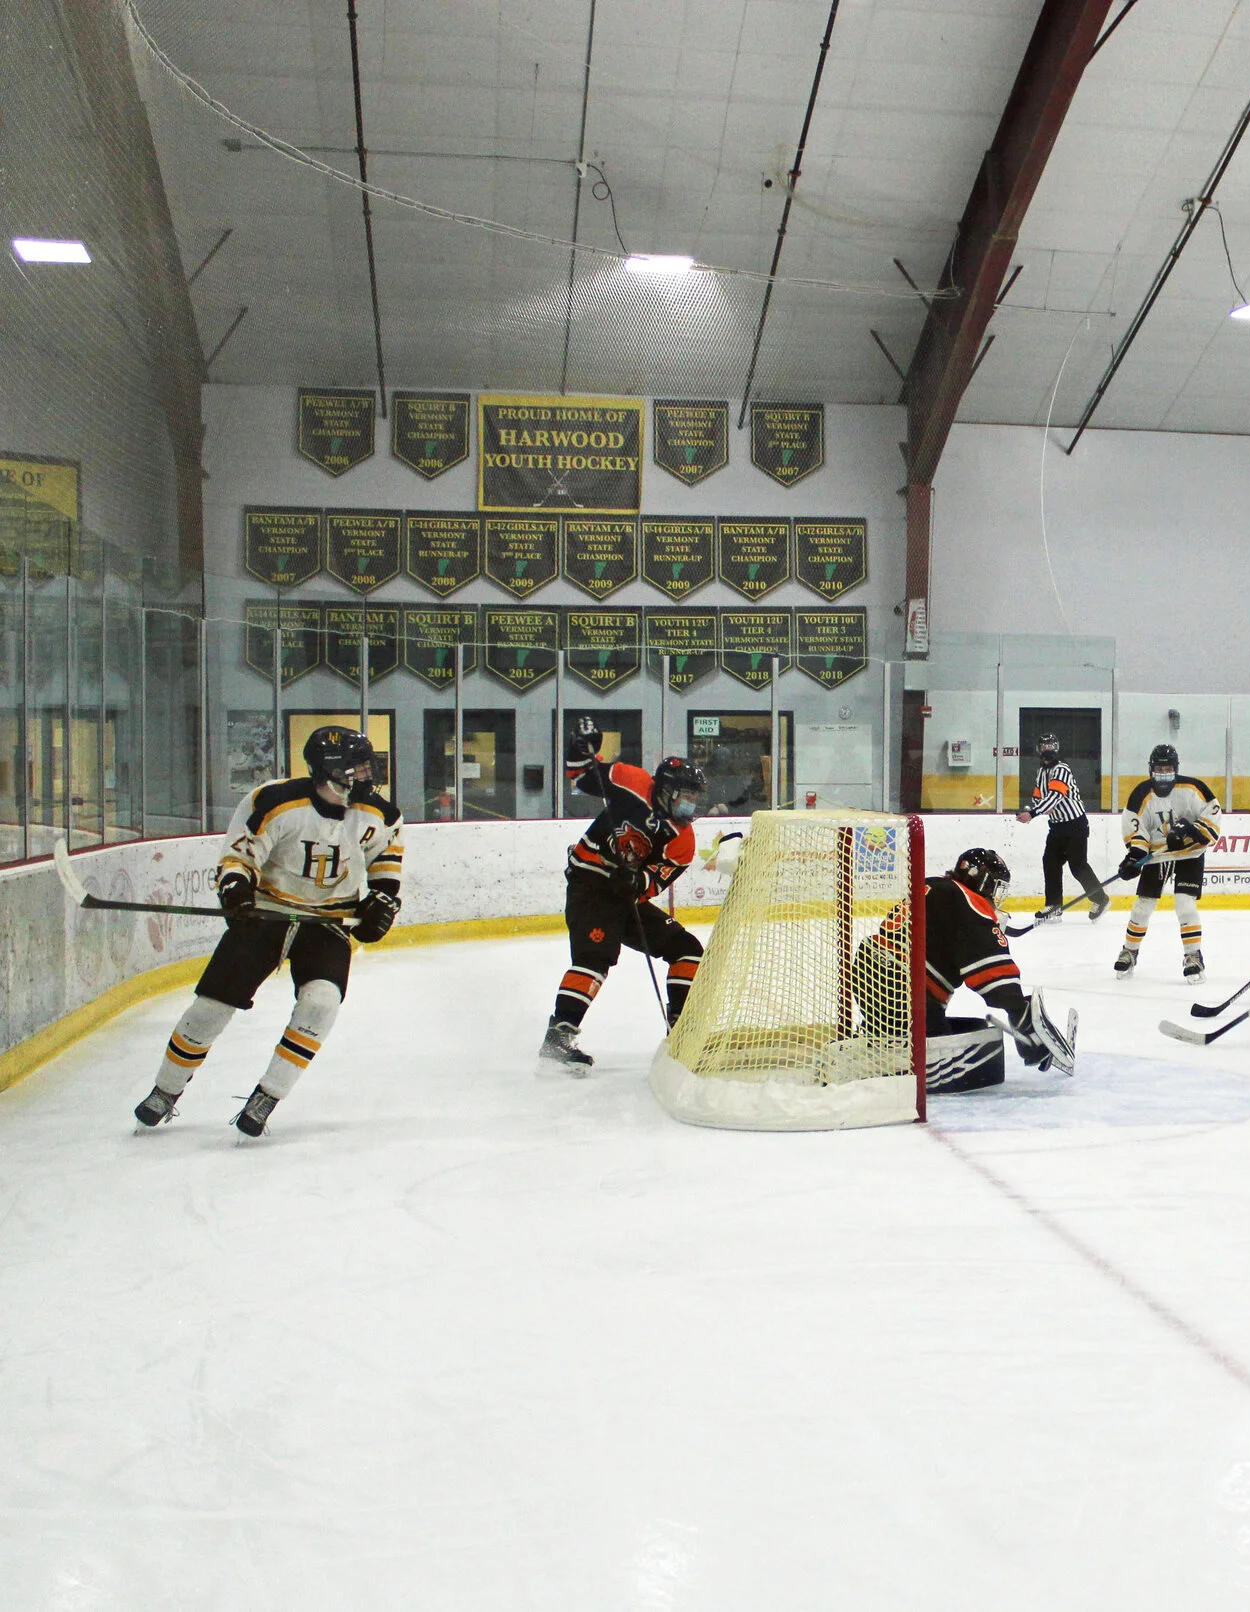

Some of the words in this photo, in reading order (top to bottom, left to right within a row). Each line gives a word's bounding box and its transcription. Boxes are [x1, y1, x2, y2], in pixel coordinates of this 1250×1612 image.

[407, 403, 446, 412] SQUIRT
[409, 412, 454, 421] VERMONT
[499, 408, 551, 421] PROUD
[557, 410, 602, 421] HOME
[607, 412, 628, 423] OF
[764, 413, 801, 422] SQUIRT
[419, 423, 445, 431] STATE
[408, 432, 455, 440] CHAMPION
[499, 429, 625, 449] HARWOOD
[419, 459, 443, 468] 2006
[485, 453, 553, 469] YOUTH
[557, 455, 639, 471] HOCKEY
[680, 465, 703, 474] 2007
[777, 467, 799, 475] 2007
[251, 516, 295, 525] BANTAM
[333, 519, 374, 528] PEEWEE
[377, 520, 396, 529] A/B
[429, 521, 459, 529] GIRLS
[460, 522, 478, 530] A/B
[506, 523, 537, 531] GIRLS
[538, 524, 556, 532] A/B
[569, 524, 611, 533] BANTAM
[613, 525, 633, 533] A/B
[342, 529, 386, 537] VERMONT
[421, 531, 466, 539] VERMONT
[663, 526, 693, 534] GIRLS
[694, 527, 712, 535] A/B
[723, 526, 766, 535] BANTAM
[767, 527, 786, 535] A/B
[815, 527, 845, 535] GIRLS
[845, 528, 863, 536] A/B
[499, 533, 544, 541] VERMONT
[579, 534, 622, 542] VERMONT
[656, 536, 699, 544] VERMONT
[732, 536, 776, 544] VERMONT
[810, 537, 852, 545] VERMONT
[350, 539, 377, 547] STATE
[430, 541, 457, 549] STATE
[508, 542, 535, 550] STATE
[257, 546, 308, 554] CHAMPION
[357, 549, 385, 557] PLACE
[665, 545, 691, 553] STATE
[818, 546, 843, 554] STATE
[418, 550, 469, 558] RUNNER-UP
[514, 552, 542, 560] PLACE
[577, 553, 624, 561] CHAMPION
[653, 554, 703, 562] RUNNER-UP
[731, 555, 778, 563] CHAMPION
[351, 575, 376, 584] 2008
[431, 577, 456, 586] 2008
[510, 579, 534, 588] 2009
[588, 579, 613, 589] 2009
[666, 580, 690, 590] 2009
[742, 581, 767, 590] 2010
[819, 581, 843, 590] 2010
[387, 613, 395, 622] A
[407, 614, 461, 627] SQUIRT
[464, 615, 473, 625] B
[491, 615, 543, 626] PEEWEE
[545, 616, 554, 626] A
[728, 616, 765, 624] YOUTH
[766, 616, 784, 624] 12U
[804, 616, 840, 624] YOUTH
[841, 616, 858, 624] 10U
[571, 616, 622, 629] SQUIRT
[625, 617, 635, 627] B
[654, 619, 690, 627] YOUTH
[692, 619, 709, 627] 12U
[666, 629, 691, 637] TIER
[816, 626, 841, 634] TIER
[428, 668, 453, 678] 2014
[509, 669, 535, 678] 2015
[590, 669, 616, 679] 2016
[745, 671, 769, 680] 2018
[820, 671, 843, 680] 2018
[670, 674, 694, 683] 2017
[1211, 875, 1224, 884] Oil
